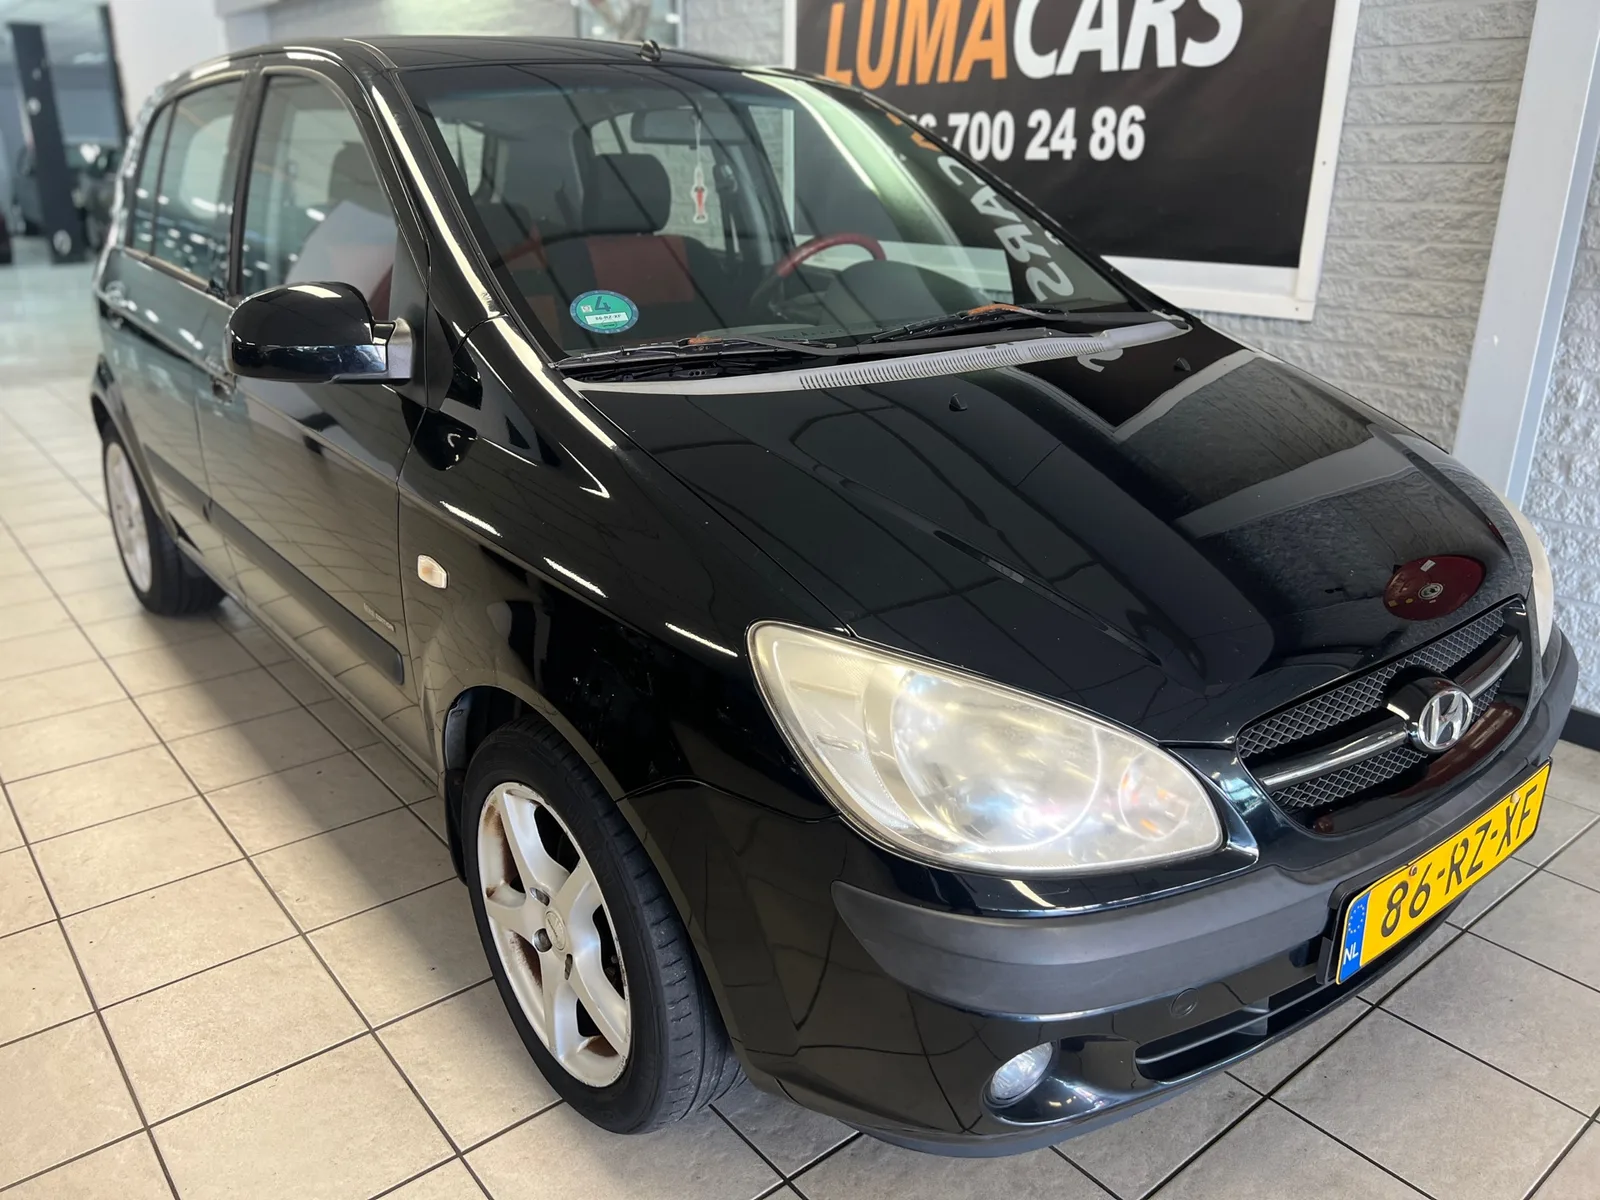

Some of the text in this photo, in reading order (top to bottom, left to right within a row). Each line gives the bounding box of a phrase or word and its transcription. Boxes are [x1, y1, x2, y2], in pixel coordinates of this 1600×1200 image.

[1025, 107, 1077, 160] 24
[1089, 104, 1146, 161] 86
[1380, 783, 1538, 938] 86-RZ-XF
[1343, 942, 1359, 966] NL
